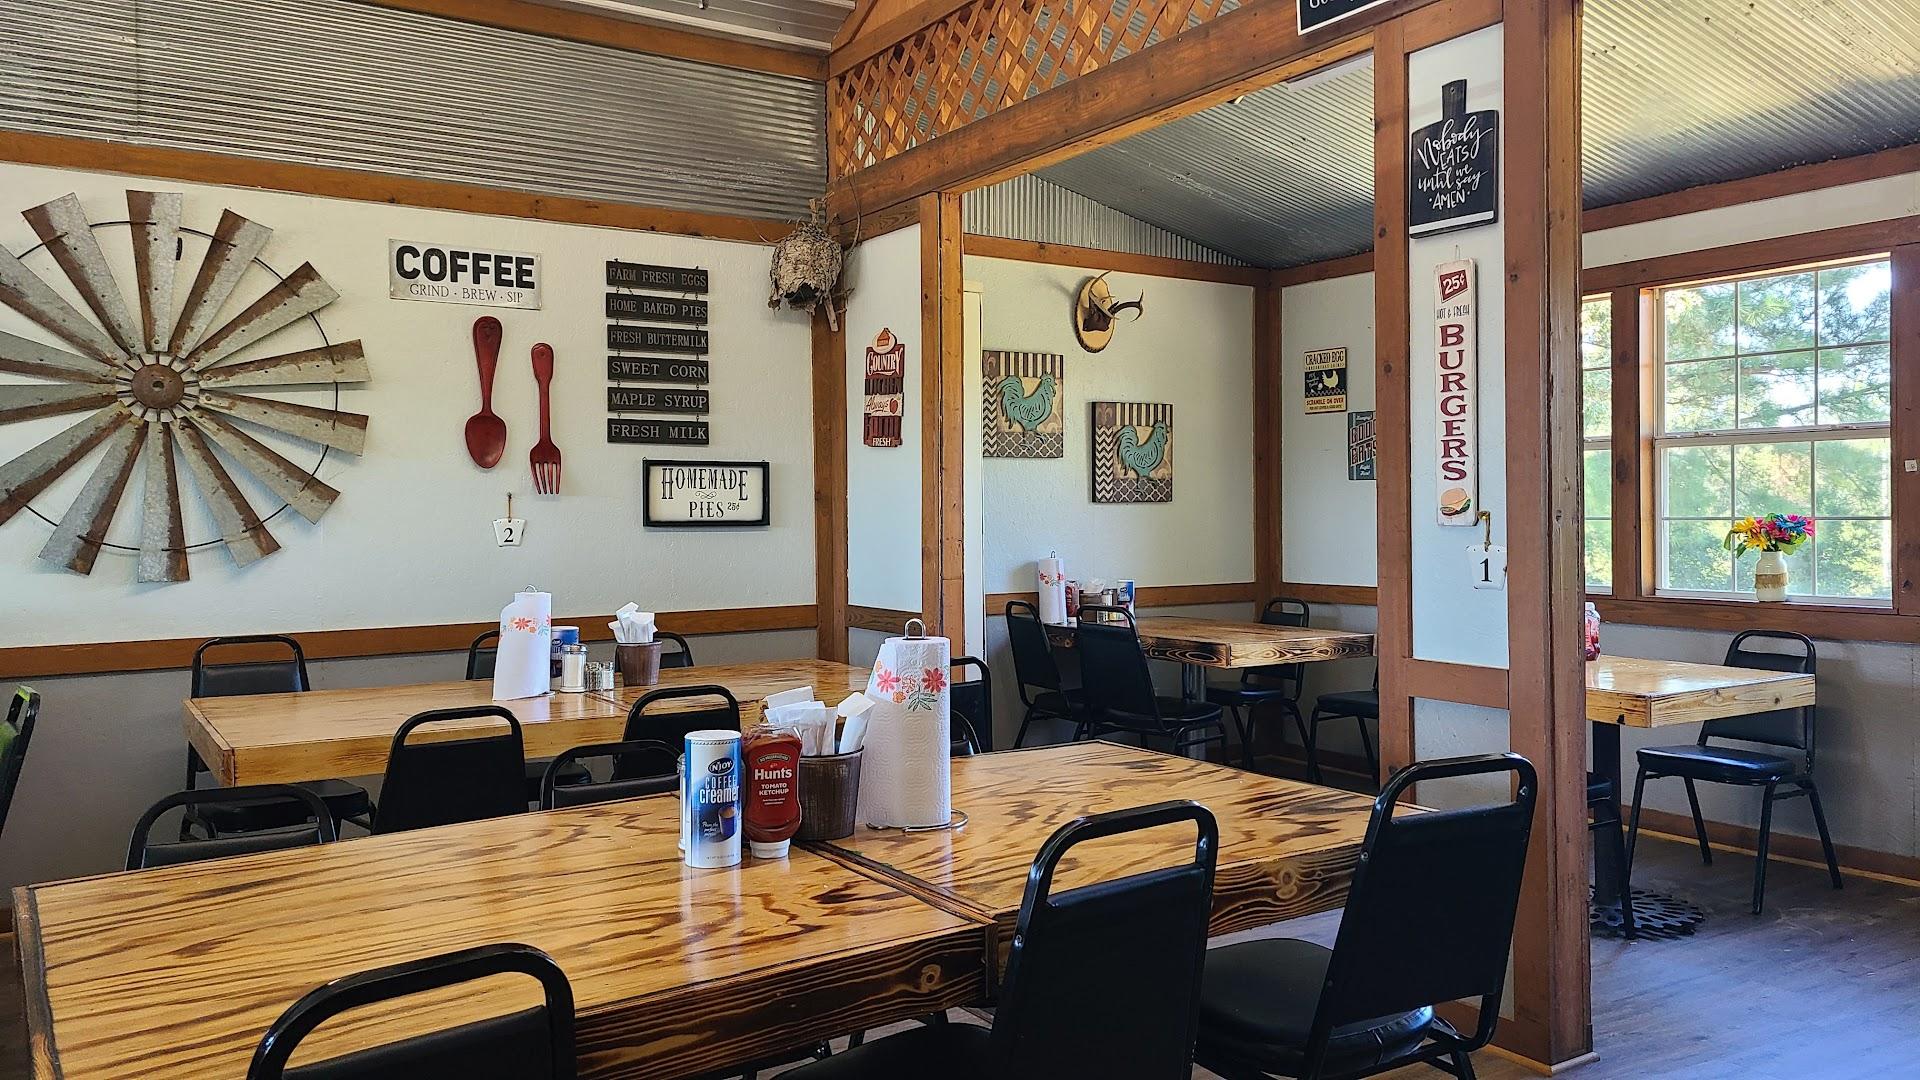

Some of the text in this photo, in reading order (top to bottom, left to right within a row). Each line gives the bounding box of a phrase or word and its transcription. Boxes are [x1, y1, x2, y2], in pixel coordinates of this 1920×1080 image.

[1418, 115, 1493, 169] Nobody
[1440, 145, 1469, 170] EATS
[1418, 164, 1472, 191] until we
[1456, 170, 1488, 190] say
[1432, 188, 1466, 210] AMEN
[396, 245, 535, 289] COFFEE
[609, 267, 706, 287] FARM FRESH EGGS
[409, 283, 523, 303] GRIND BREW SIP
[1443, 273, 1465, 295] 25¢
[610, 298, 707, 318] HOME BAKED PIES
[1437, 307, 1446, 320] HOT
[1453, 304, 1470, 318] FRESH
[610, 330, 707, 348] FRESH BUTTERMILK
[867, 347, 903, 376] COUNTRY
[1305, 350, 1344, 366] CRACKED EGG
[611, 361, 707, 379] SWEET CORN
[611, 392, 707, 409] MAPLE SYRUP
[1439, 323, 1469, 481] BURGERS
[611, 424, 707, 440] FRESH MILK
[872, 437, 891, 447] FRESH
[661, 467, 748, 501] HOMEMADE
[689, 501, 740, 518] PIES 25¢
[504, 527, 513, 542] 2
[1480, 558, 1492, 582] 1
[705, 775, 738, 789] COFFEE
[759, 788, 789, 796] KETCHUP
[761, 782, 788, 790] TOMATO
[699, 785, 740, 804] creamer
